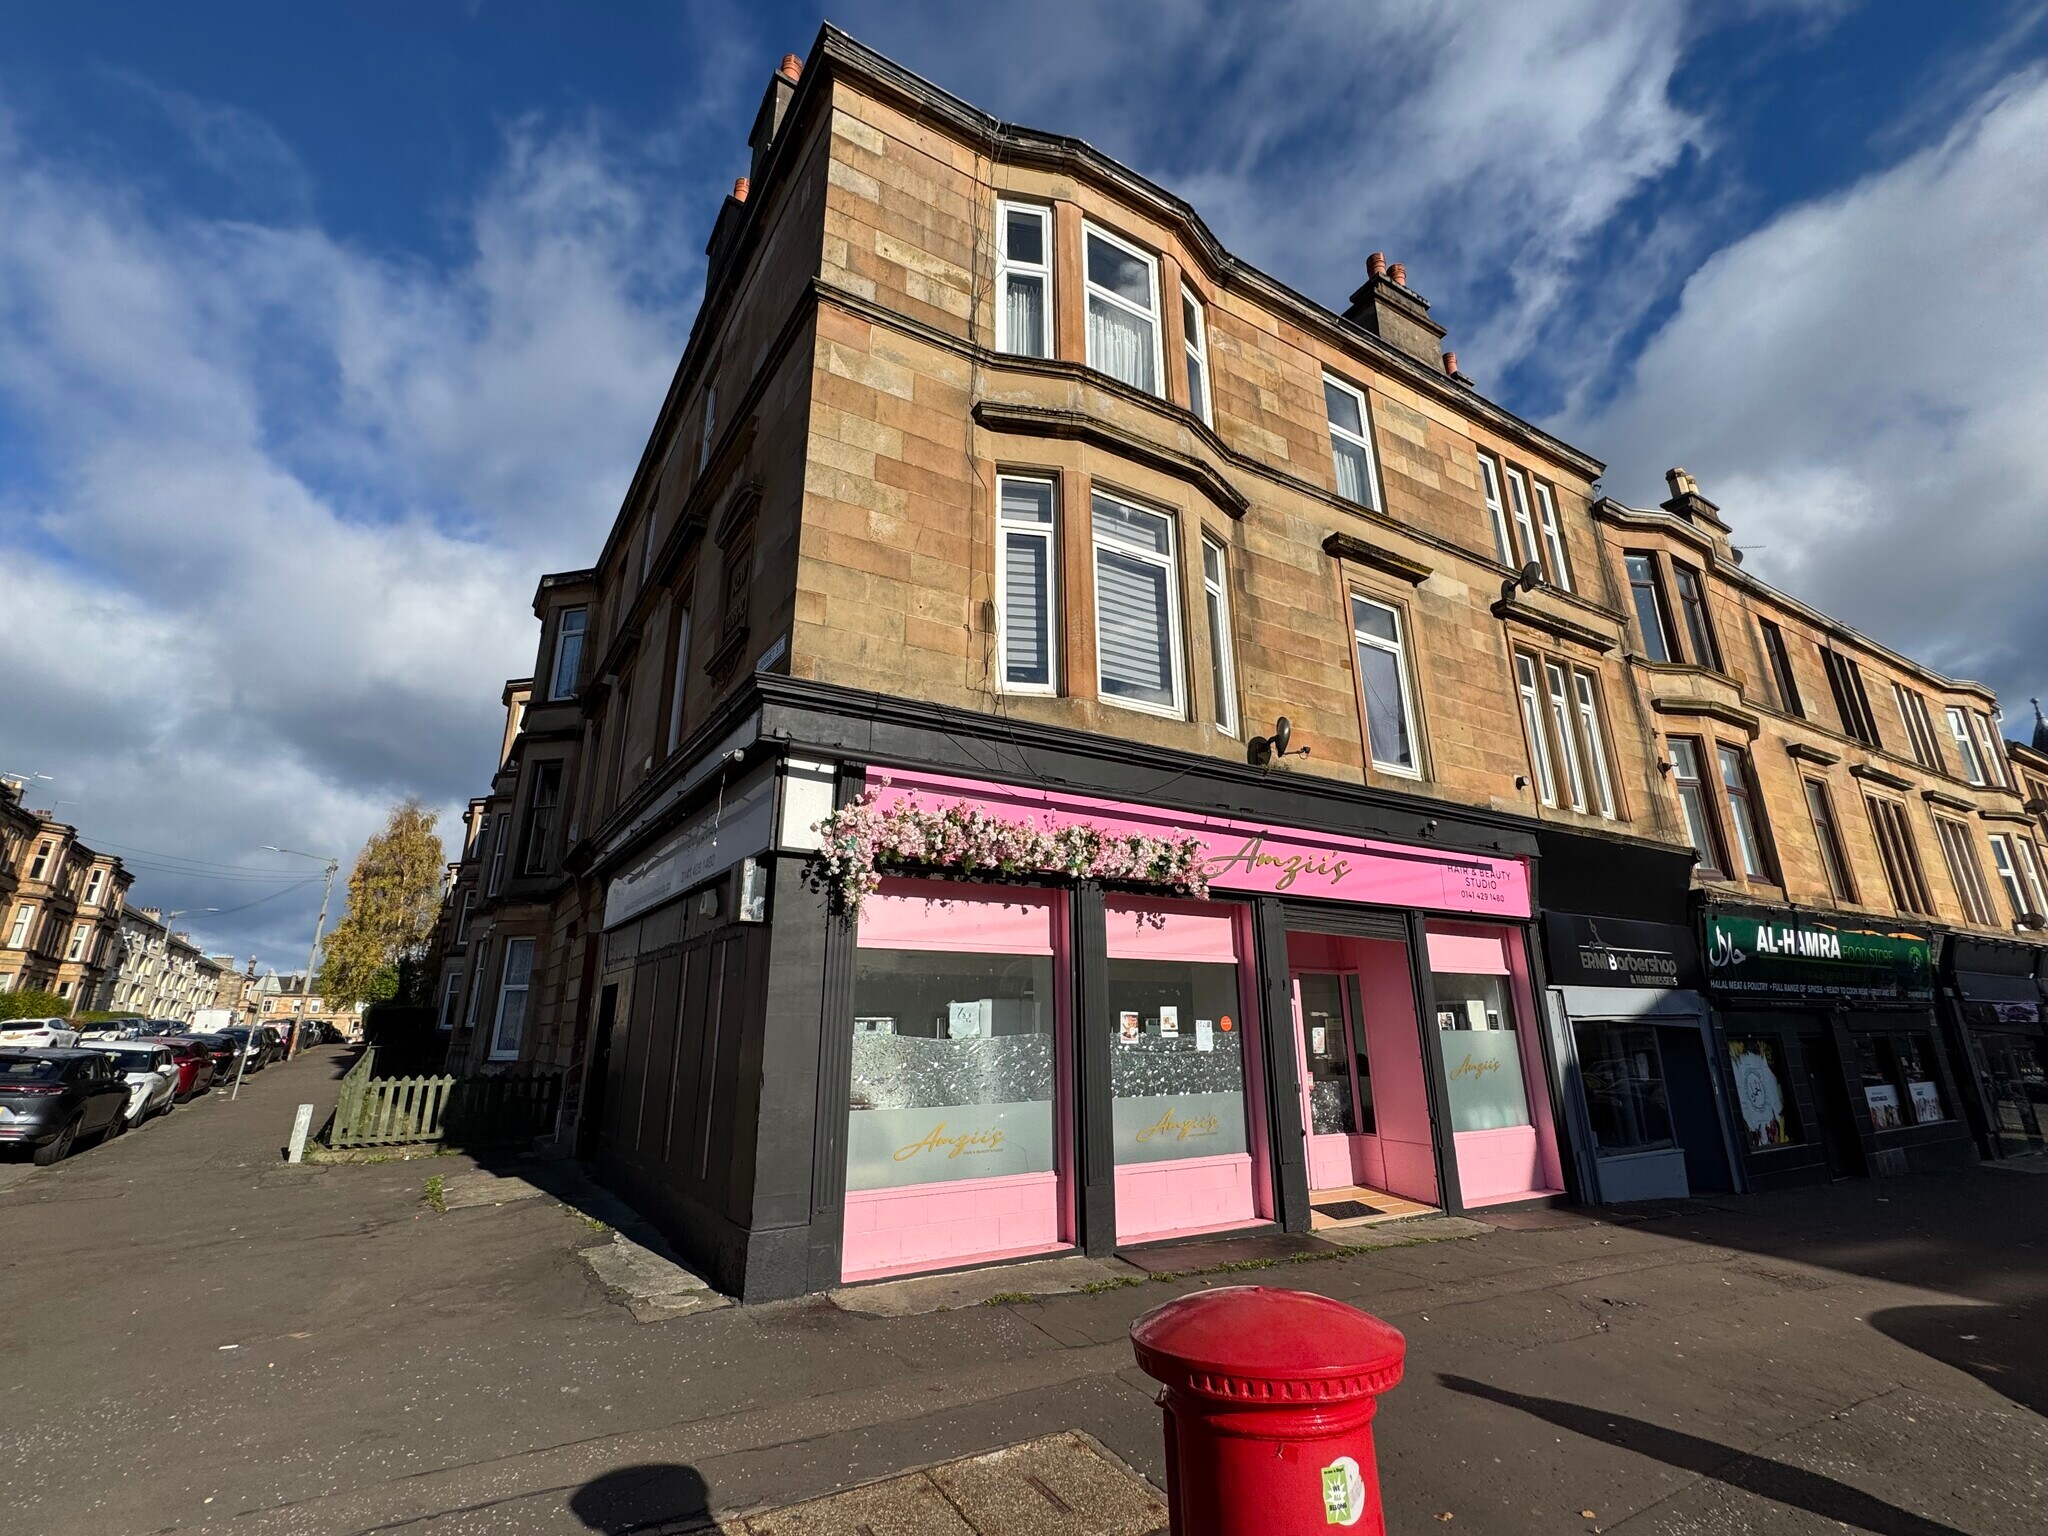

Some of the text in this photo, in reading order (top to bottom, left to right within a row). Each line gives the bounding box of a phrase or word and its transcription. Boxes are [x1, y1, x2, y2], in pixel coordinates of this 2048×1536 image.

[1447, 864, 1468, 875] HAIR
[1480, 868, 1511, 880] BEAUTY
[1465, 877, 1497, 890] STUDIO
[1461, 890, 1505, 902] 0141 429 1480
[1757, 925, 1842, 959] AL-HAMRA
[1842, 945, 1867, 961] FOOD
[1710, 980, 1728, 989] HALAL
[1728, 981, 1743, 990] MEAT
[1748, 982, 1768, 991] POULTRY
[1772, 983, 1784, 992] FULL
[1799, 984, 1807, 993] OF
[1329, 1502, 1347, 1511] BELONG
